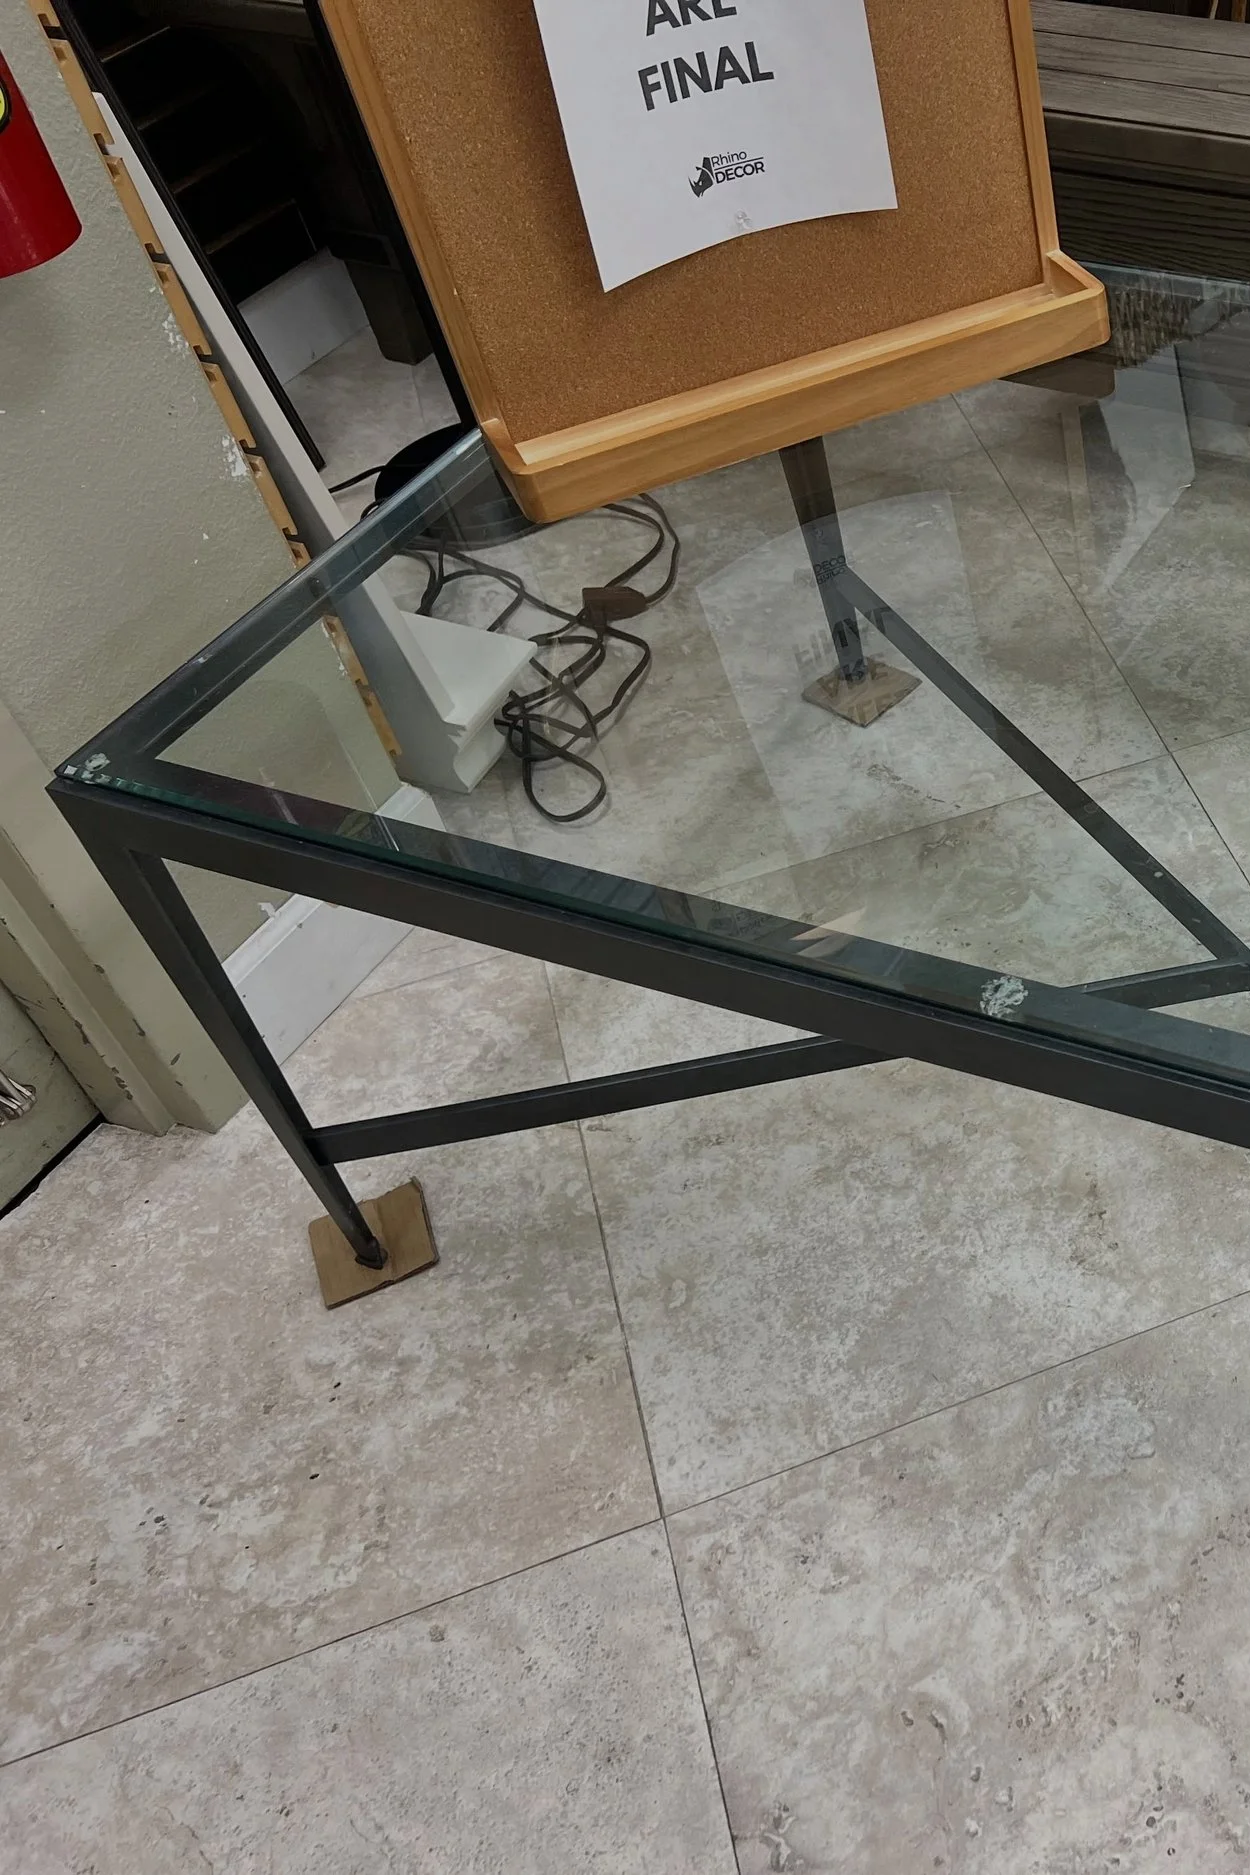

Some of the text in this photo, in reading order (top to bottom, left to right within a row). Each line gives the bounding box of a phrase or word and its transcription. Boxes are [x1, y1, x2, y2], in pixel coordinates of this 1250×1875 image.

[638, 41, 775, 111] FINAL
[711, 151, 747, 167] Rhino
[715, 162, 765, 183] DECOR
